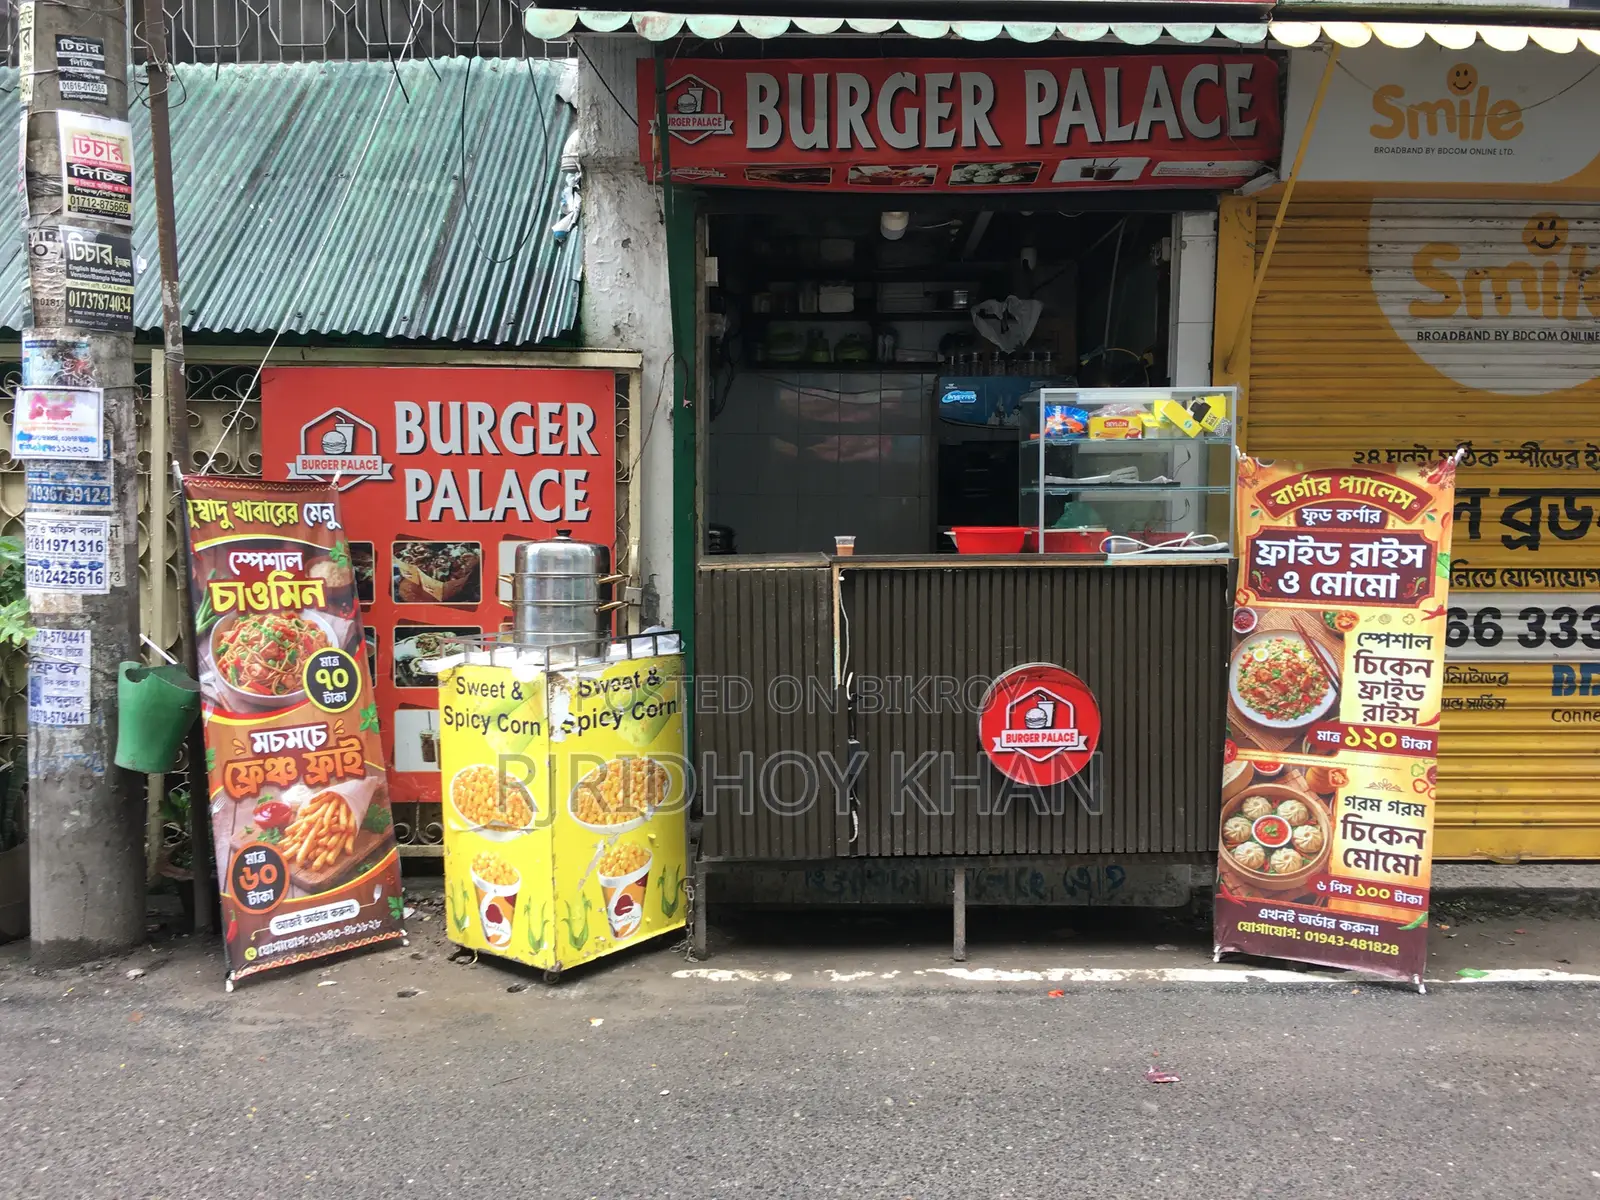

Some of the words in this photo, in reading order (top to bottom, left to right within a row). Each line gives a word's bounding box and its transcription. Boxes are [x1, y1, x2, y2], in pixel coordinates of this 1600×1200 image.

[60, 39, 100, 54] টিচার
[746, 70, 1002, 150] BURGER
[1025, 63, 1259, 145] PALACE
[1370, 84, 1524, 140] Smile
[668, 117, 690, 127] URGER
[692, 117, 722, 127] PALACE
[72, 136, 124, 163] টিচার
[1374, 146, 1423, 156] BROADBAND
[1426, 147, 1436, 156] BY
[1438, 147, 1467, 157] BDCOM
[1470, 147, 1498, 157] ONLINE
[1500, 148, 1514, 158] LTD.
[70, 196, 129, 213] 01712-875669
[67, 232, 113, 265] টিচার
[1409, 241, 1600, 320] Smil
[69, 290, 131, 313] 01737874034
[1417, 331, 1491, 341] BROADBAND
[1495, 331, 1510, 341] BY
[1513, 331, 1558, 341] BDCOM
[394, 401, 600, 456] BURGER
[302, 460, 338, 470] BURGER
[341, 460, 378, 470] PALACE
[1353, 449, 1380, 465] ২৪
[403, 469, 591, 522] PALACE
[1271, 474, 1333, 505] বার্গার
[1339, 476, 1417, 511] প্যালেস
[232, 500, 299, 527] খাবারের
[303, 502, 342, 530] মেনু
[1302, 507, 1333, 526] ফুড
[1336, 505, 1382, 524] কর্ণার
[229, 551, 303, 576] স্পেশাল
[1255, 535, 1342, 567] ফ্রাইড
[1349, 538, 1428, 569] রাইস
[1278, 571, 1300, 594] ও
[1310, 571, 1401, 599] মোমো
[1356, 631, 1434, 652] স্পেশাল
[318, 655, 340, 668] মাত্র
[1353, 649, 1434, 679] চিকেন
[315, 668, 350, 690] ৭০
[456, 675, 505, 698] Sweet
[511, 680, 523, 701] &
[578, 672, 641, 700] Sweet
[646, 664, 661, 686] &
[1358, 679, 1427, 703] ফ্রাইড
[323, 690, 348, 705] টাকা
[443, 704, 502, 735] Spicy
[506, 713, 552, 736] Corn
[631, 699, 677, 726] Corn
[1361, 701, 1421, 725] রাইস
[251, 723, 328, 754] মচমচে
[1006, 733, 1039, 744] BURGER
[1041, 731, 1075, 743] PALACE
[1317, 730, 1341, 743] মাত্র
[1345, 727, 1398, 751] ১২০
[1400, 736, 1433, 752] টাকা
[224, 756, 299, 798] ফ্রেঞ্চ
[302, 737, 365, 785] ফ্রাই
[1344, 795, 1382, 813] গরম
[1388, 800, 1427, 818] গরম
[1340, 814, 1427, 850] চিকেন
[244, 850, 268, 865] মাত্র
[1343, 848, 1422, 878] মোমো
[239, 864, 278, 892] ৬০
[247, 890, 275, 906] টাকা
[1316, 879, 1327, 891] ৬
[1330, 880, 1353, 895] পিস
[1355, 883, 1391, 899] ১০০
[1394, 890, 1424, 906] টাকা
[275, 914, 302, 930] আজই
[304, 910, 328, 925] অর্ডার
[1258, 908, 1296, 924] এখনই
[1298, 912, 1336, 930] অর্ডার
[1339, 919, 1380, 936] করুন!
[1237, 920, 1301, 941] যোগাযোগ:
[1304, 932, 1400, 956] 01943-481828
